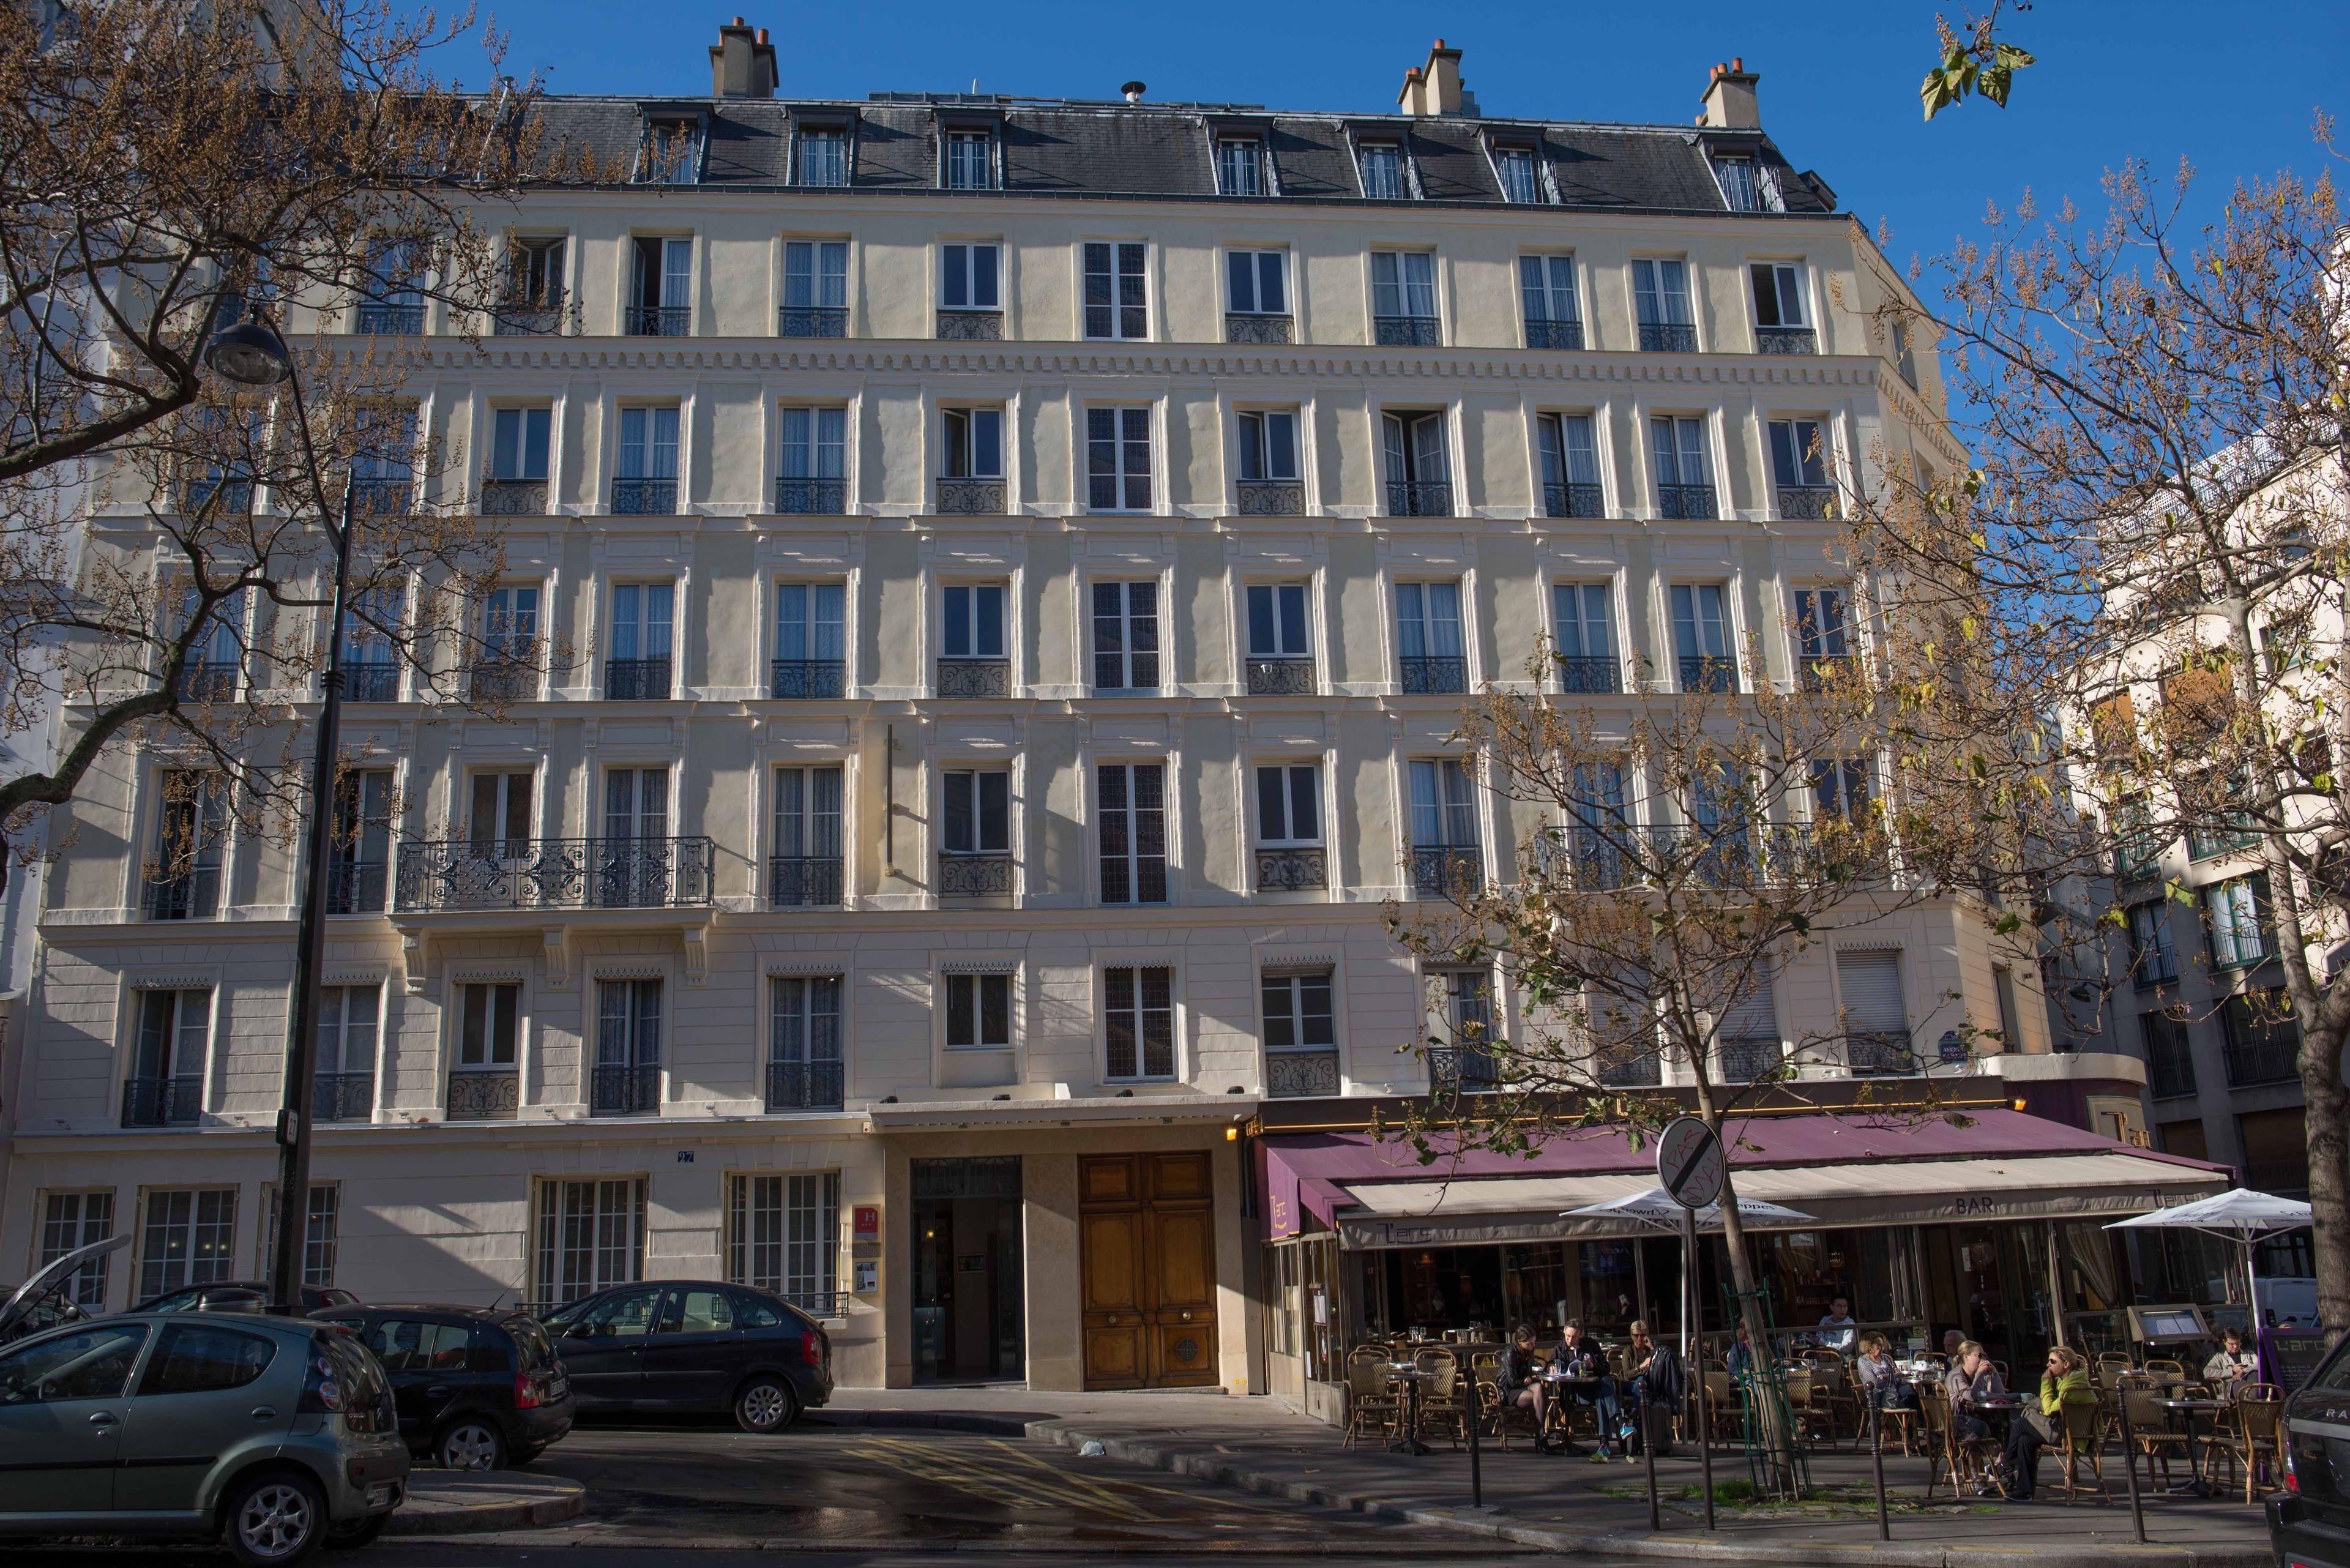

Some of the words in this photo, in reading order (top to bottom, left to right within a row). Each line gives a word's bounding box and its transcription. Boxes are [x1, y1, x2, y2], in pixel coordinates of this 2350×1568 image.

[288, 1118, 296, 1136] 27
[1956, 1196, 1994, 1215] BAR
[865, 1212, 875, 1222] H
